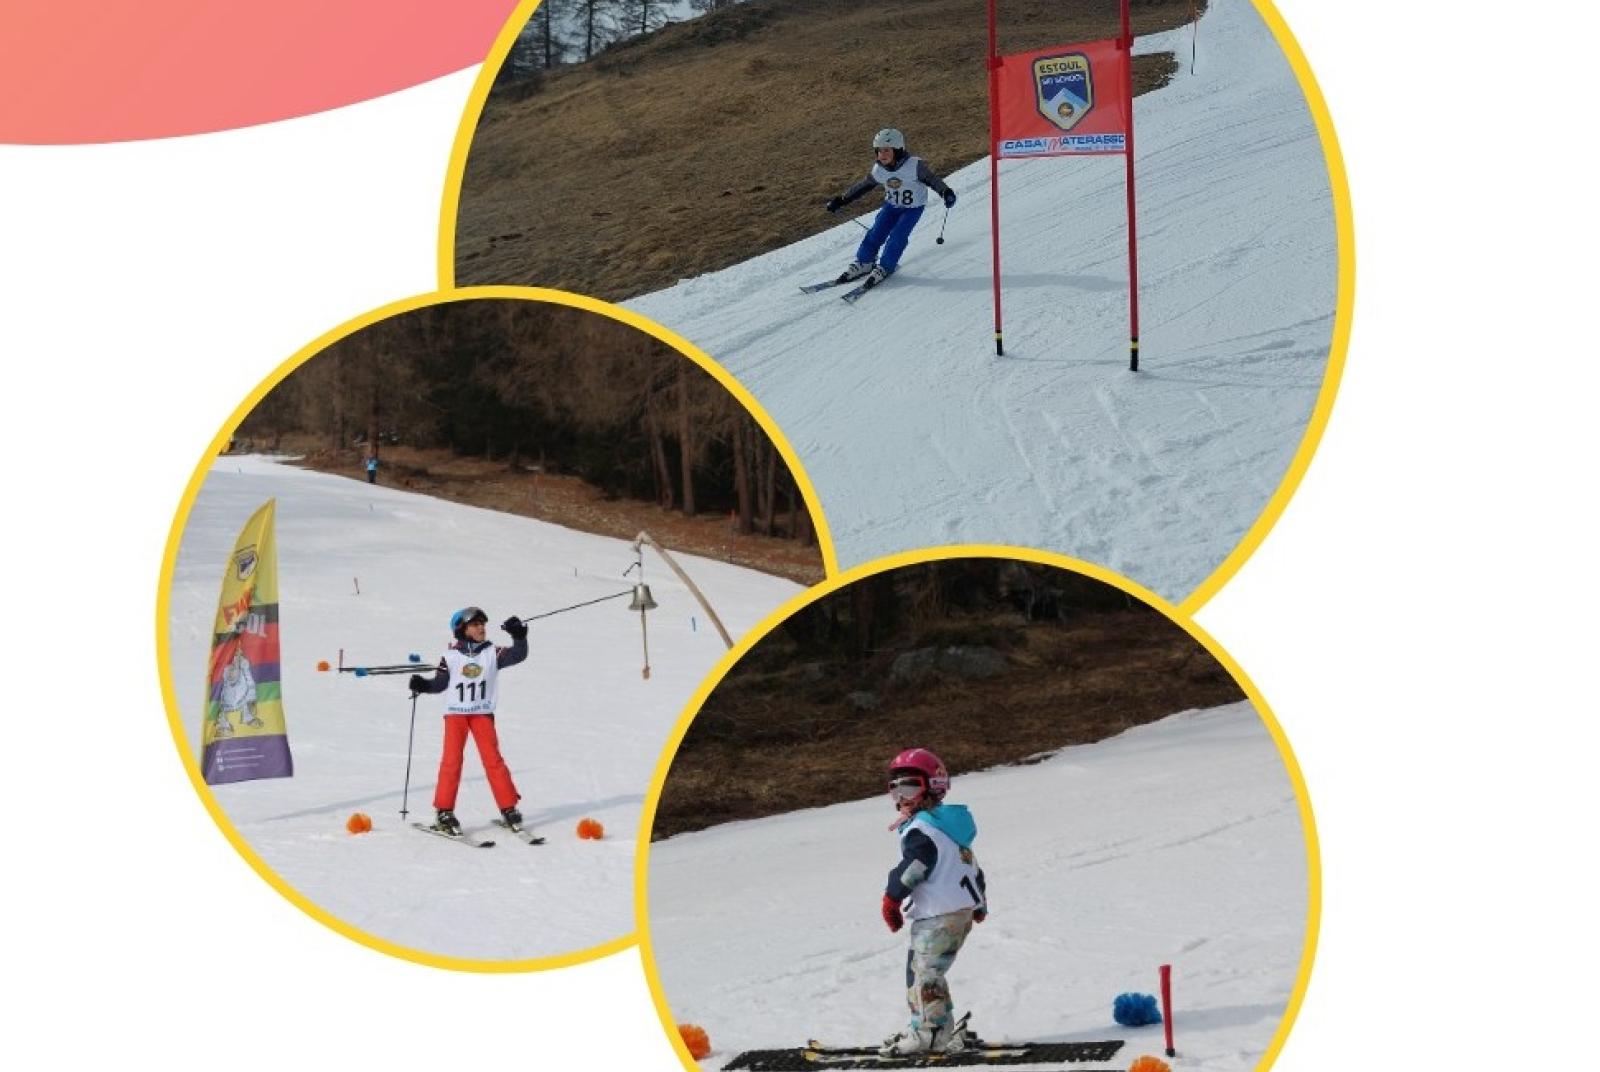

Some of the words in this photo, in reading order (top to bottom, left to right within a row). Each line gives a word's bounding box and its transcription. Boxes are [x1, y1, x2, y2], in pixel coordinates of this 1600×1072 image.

[1039, 61, 1082, 73] ESTOUL
[1055, 74, 1084, 83] SCHOOL
[1004, 139, 1042, 149] CASA
[455, 680, 487, 703] 111
